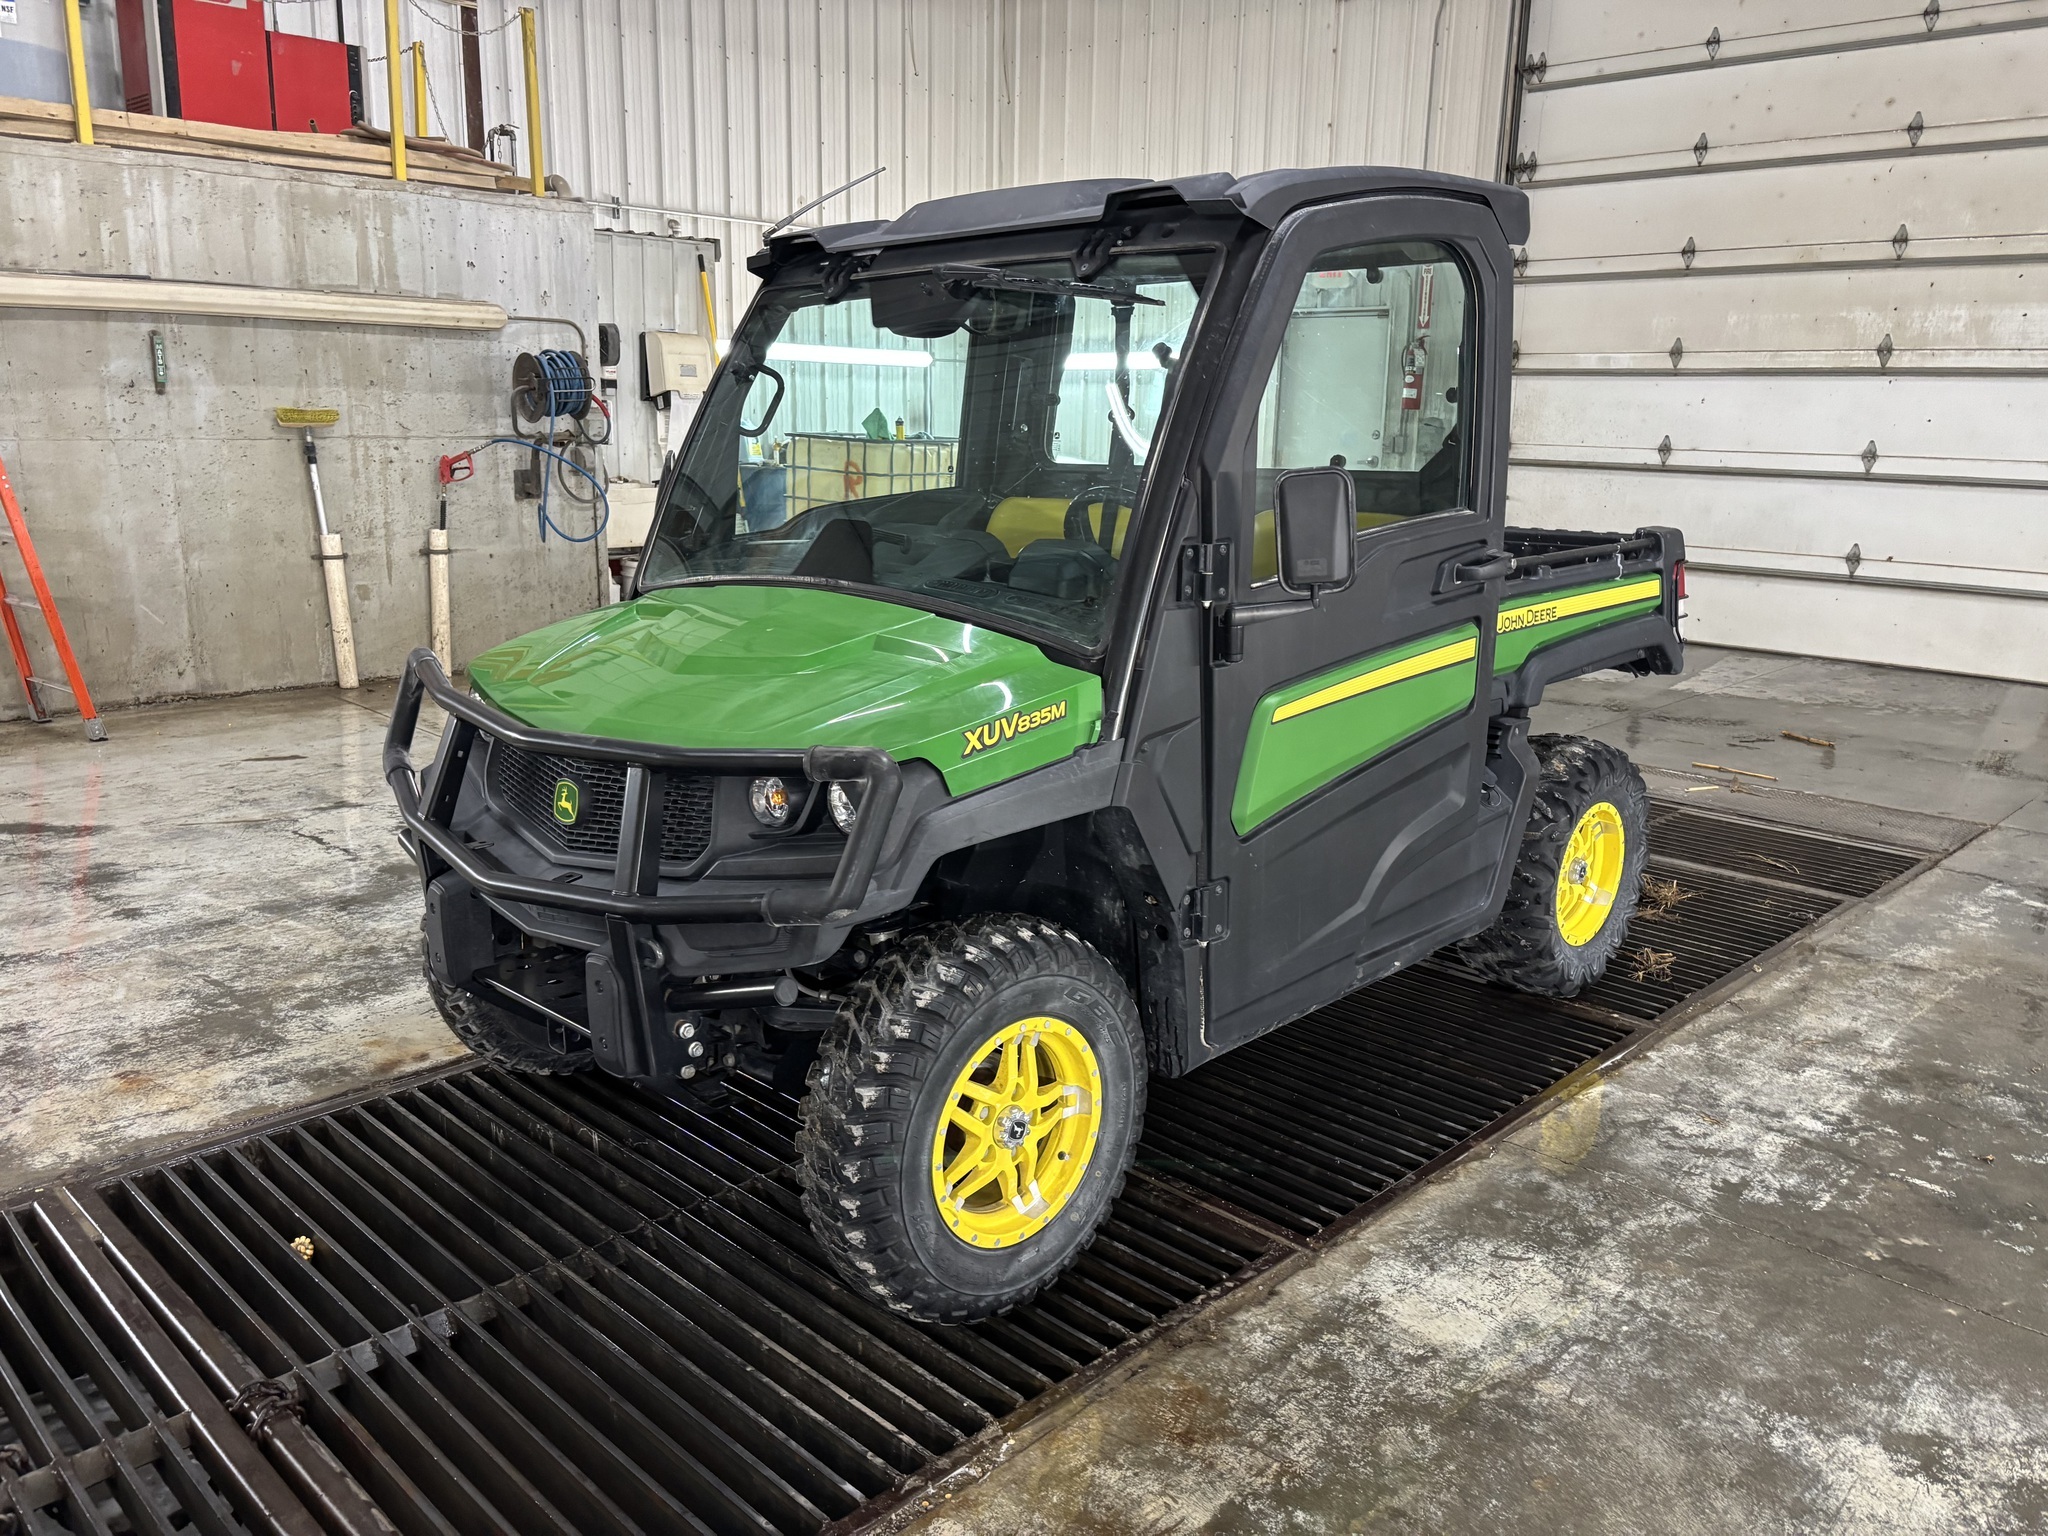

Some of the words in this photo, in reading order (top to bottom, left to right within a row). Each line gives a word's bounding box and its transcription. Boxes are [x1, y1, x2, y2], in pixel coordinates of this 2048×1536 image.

[1, 4, 14, 13] NSF
[1498, 613, 1524, 631] JOHN
[1527, 606, 1557, 624] DEERE
[1063, 986, 1125, 1046] GBC
